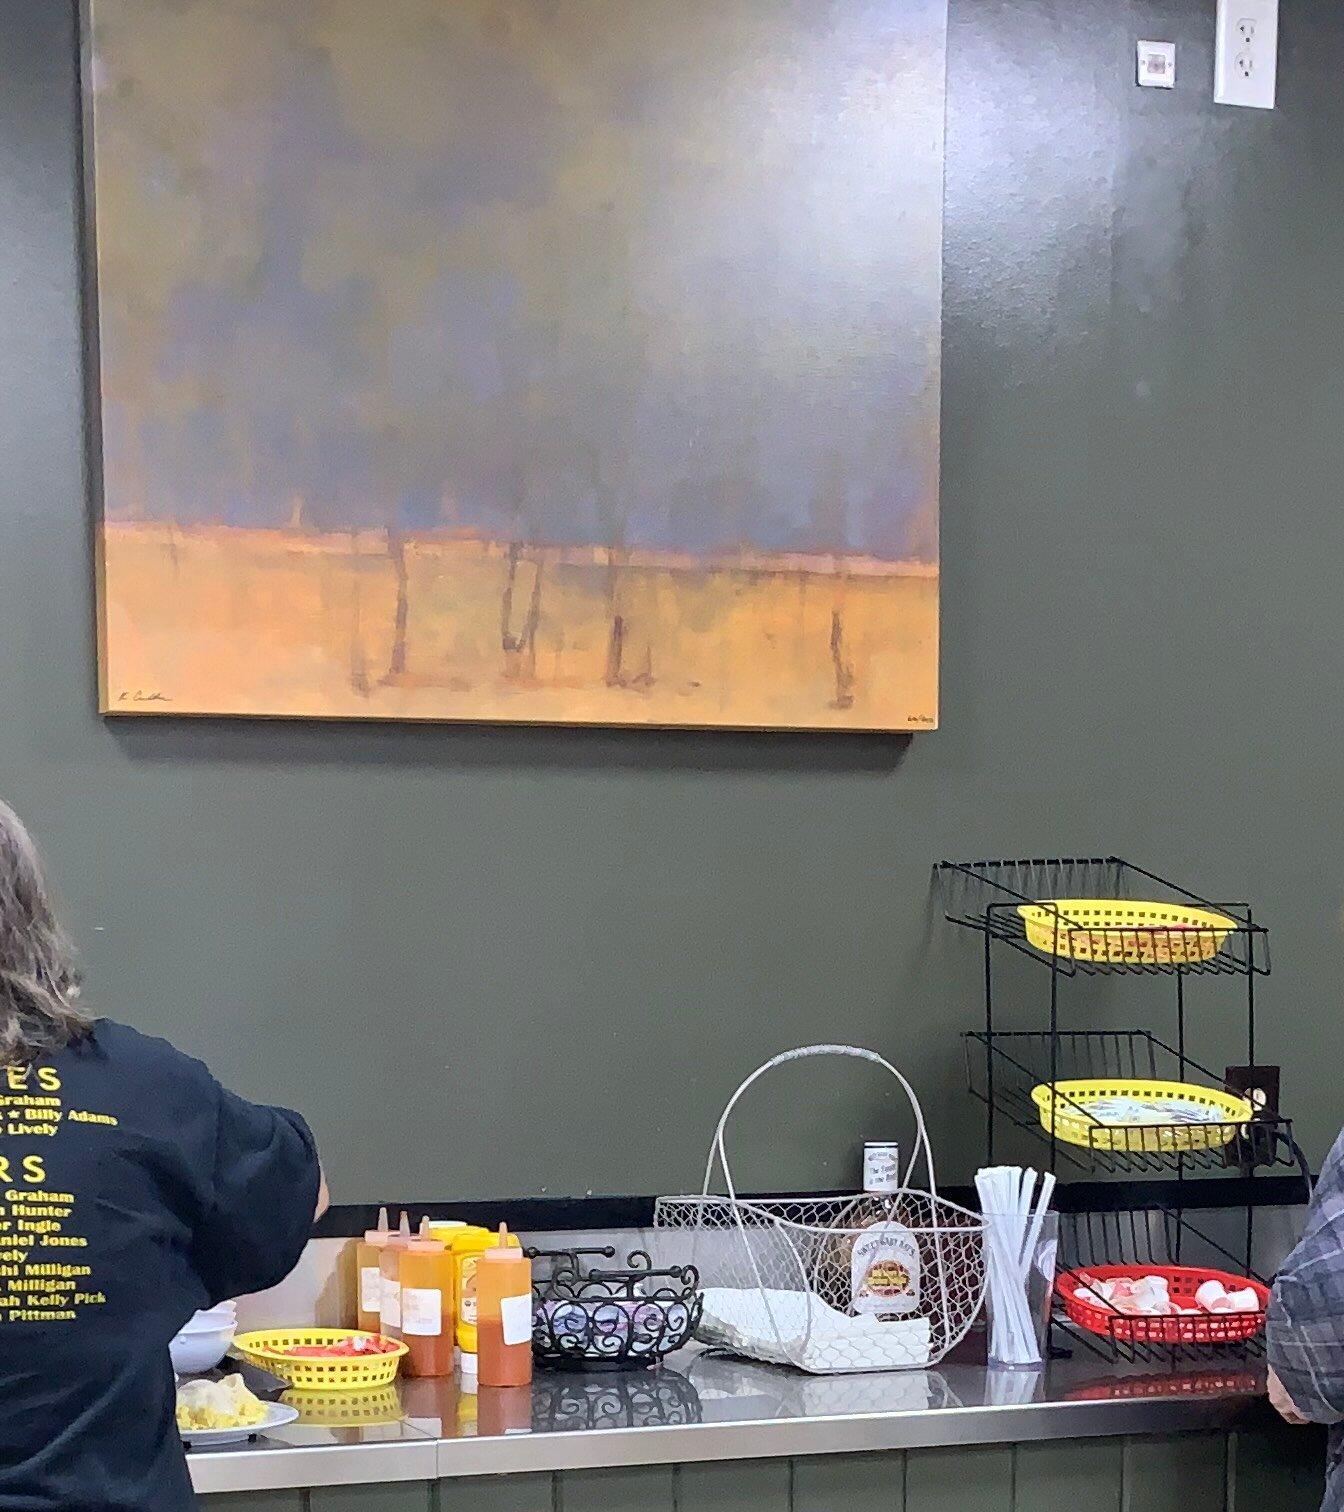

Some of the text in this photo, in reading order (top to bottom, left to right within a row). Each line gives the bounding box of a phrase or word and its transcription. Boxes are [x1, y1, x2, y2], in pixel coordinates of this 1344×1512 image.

[24, 1109, 63, 1122] Billy
[68, 1110, 118, 1126] Adams
[7, 1123, 58, 1137] Lively
[5, 1190, 75, 1203] Graham
[11, 1204, 73, 1218] Hunter
[17, 1220, 62, 1234] Ingle
[39, 1234, 88, 1247] Jones
[24, 1263, 92, 1278] Milligan
[7, 1279, 77, 1293] Milligan
[27, 1293, 70, 1308] Kelly
[73, 1291, 107, 1305] Pick
[9, 1309, 77, 1321] Pittman
